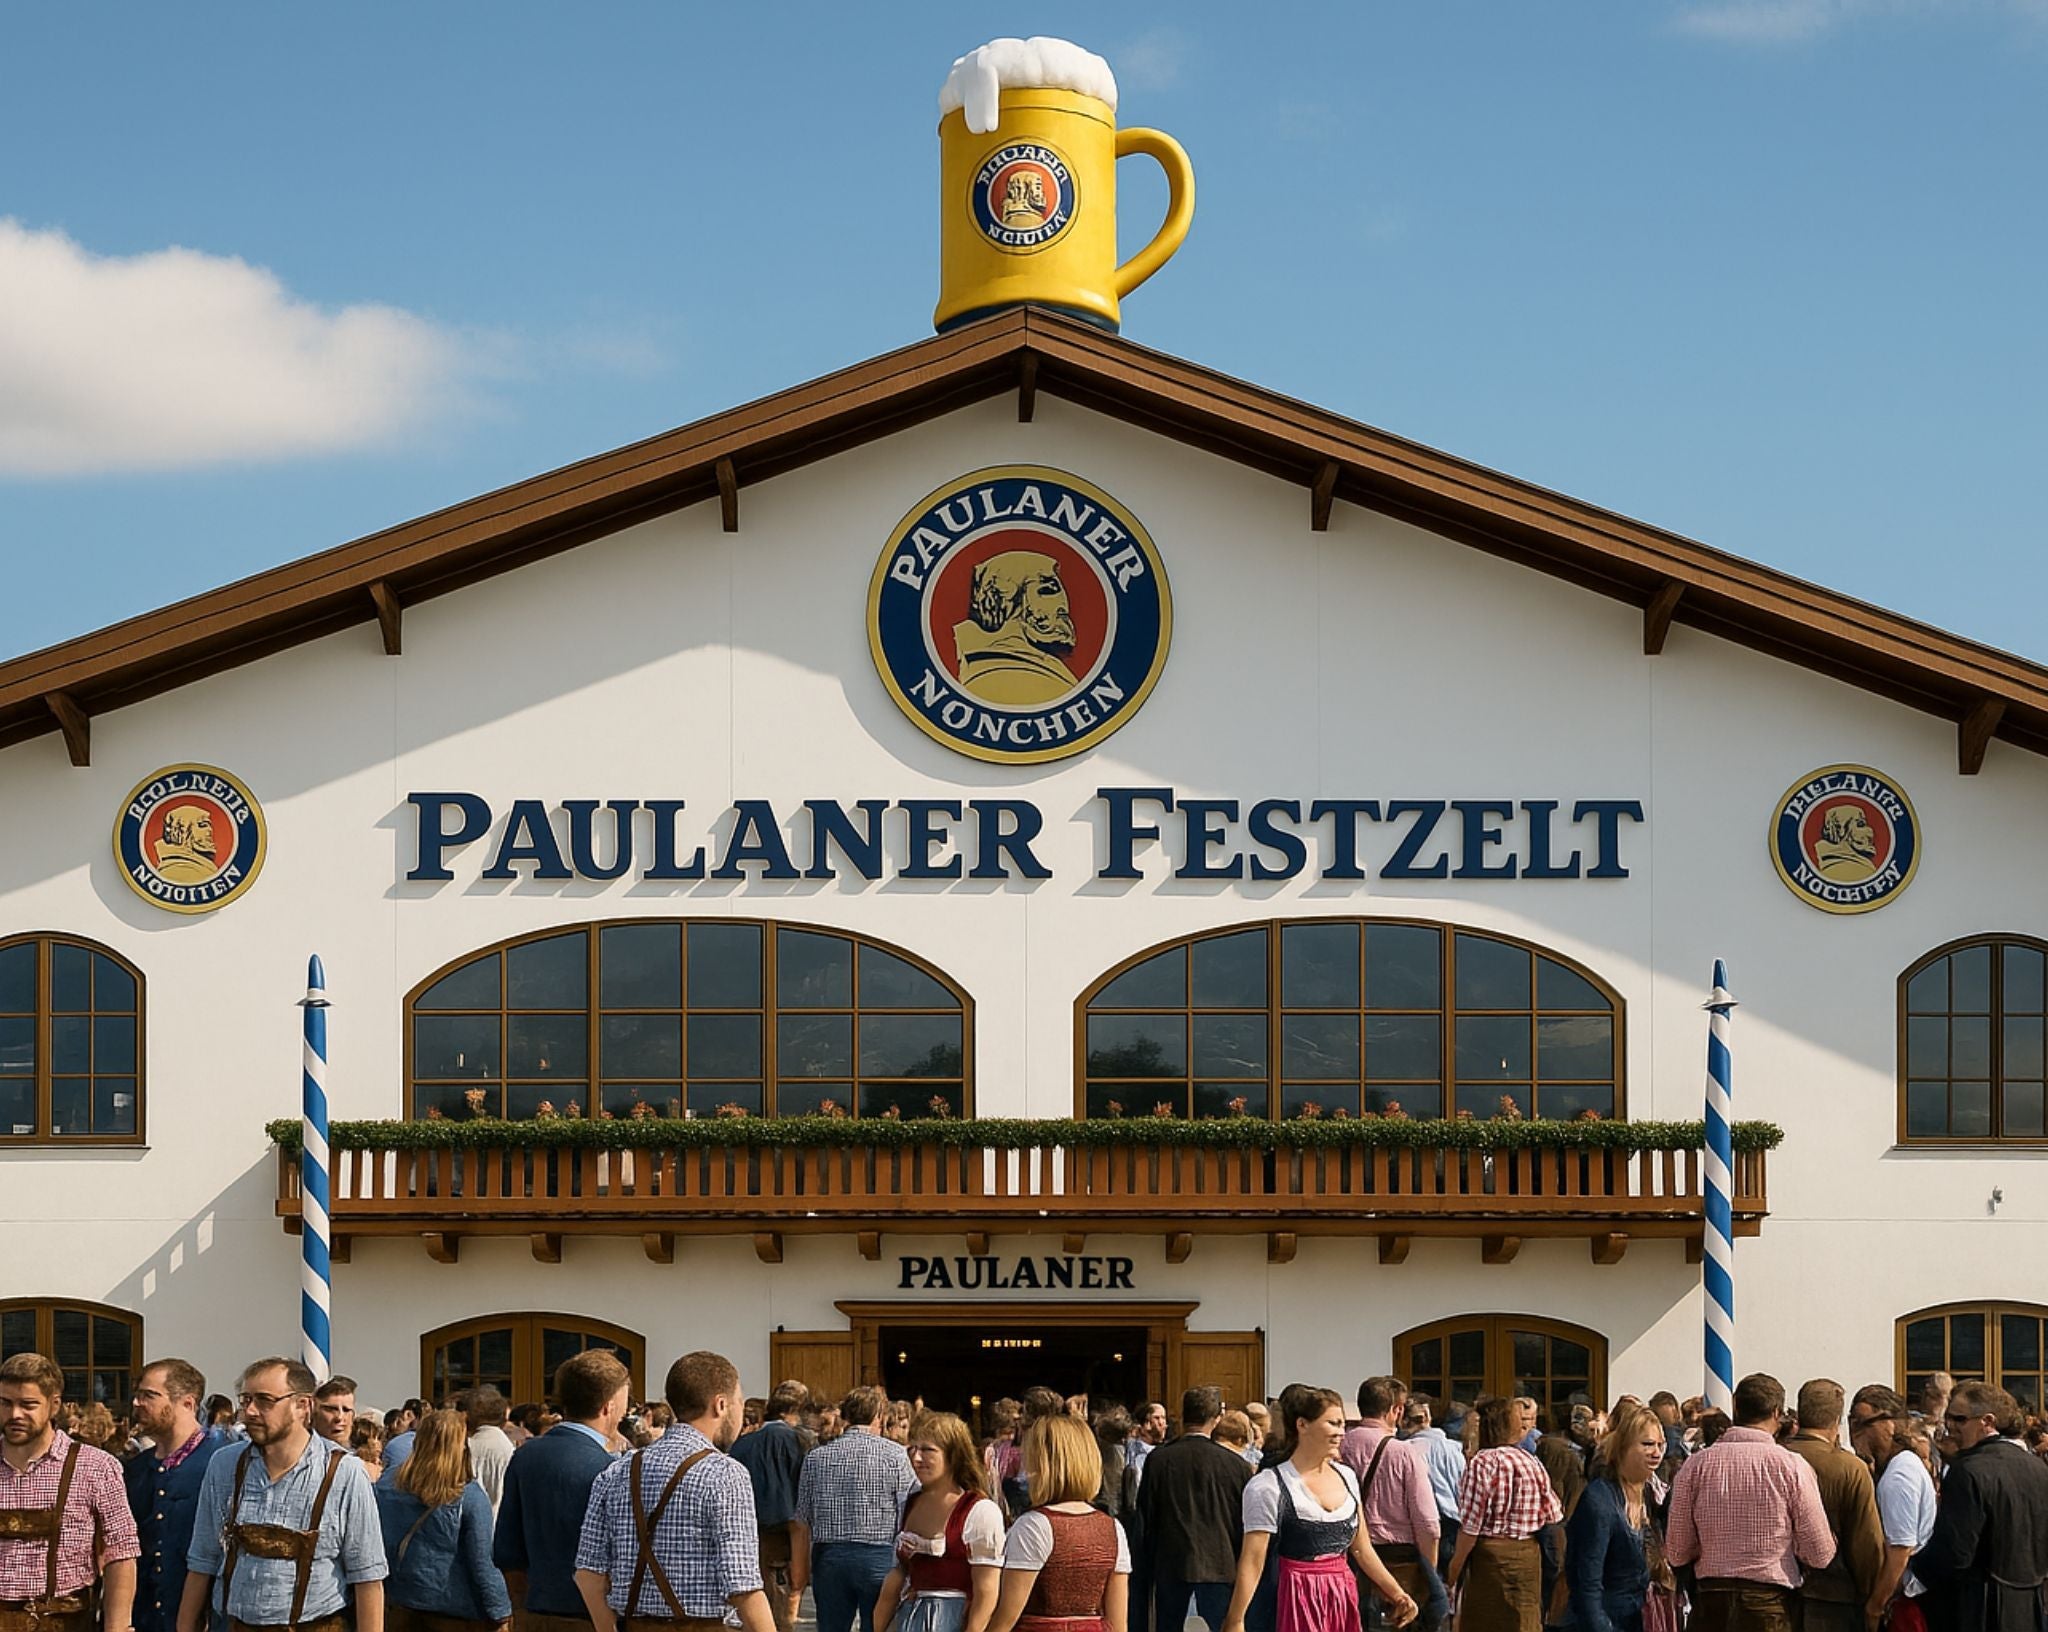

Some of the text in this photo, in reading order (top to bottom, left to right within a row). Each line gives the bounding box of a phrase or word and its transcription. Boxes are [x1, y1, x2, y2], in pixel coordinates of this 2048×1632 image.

[891, 485, 1145, 593] PAULANER
[909, 668, 1125, 744] NONCHEN
[406, 787, 1645, 881] PAULANER FESTZELT
[898, 1256, 1135, 1289] PAULANER
